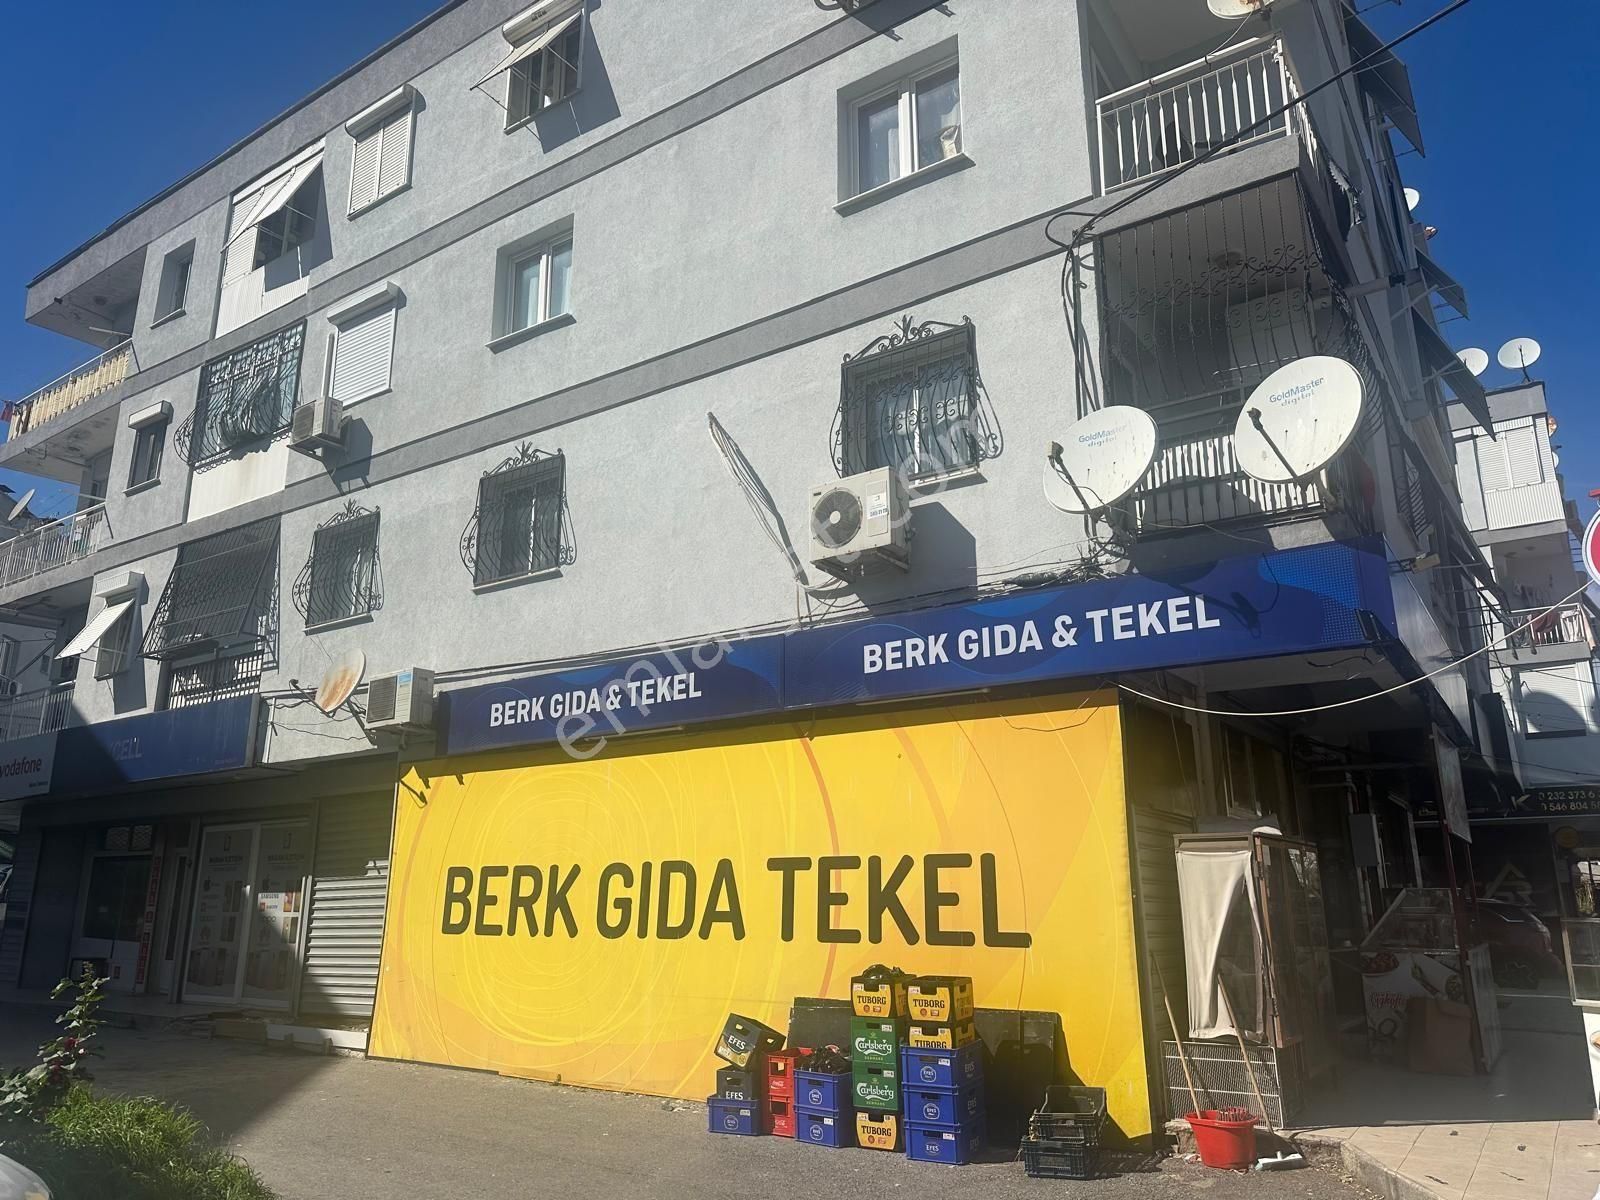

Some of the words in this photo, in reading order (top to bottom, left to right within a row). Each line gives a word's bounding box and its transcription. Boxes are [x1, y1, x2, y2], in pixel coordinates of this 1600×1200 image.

[1269, 377, 1324, 403] GoldMaster
[1281, 389, 1314, 407] digital
[863, 632, 950, 674] BERK
[958, 620, 1044, 661] GIDA
[1051, 614, 1078, 649] &
[1086, 594, 1221, 643] TEKEL
[490, 696, 545, 727] BERK
[550, 687, 601, 719] GIDA
[606, 684, 622, 711] &
[627, 672, 702, 707] TEKEL
[0, 756, 42, 777] vodafone
[1547, 791, 1566, 800] 232
[1568, 790, 1586, 799] 373
[1549, 802, 1568, 811] 546
[1569, 801, 1588, 810] 804
[441, 863, 582, 938] BERK
[596, 857, 747, 941] GIDA
[766, 852, 1033, 949] TEKEL
[857, 995, 887, 1005] TUBORG
[913, 999, 945, 1008] TUBORG
[728, 1035, 746, 1050] EFES
[855, 1037, 892, 1055] Carlsberg
[914, 1039, 946, 1049] TUBORG
[726, 1091, 744, 1100] EFES
[856, 1082, 894, 1101] Carlsberg
[861, 1126, 892, 1136] TUBORG
